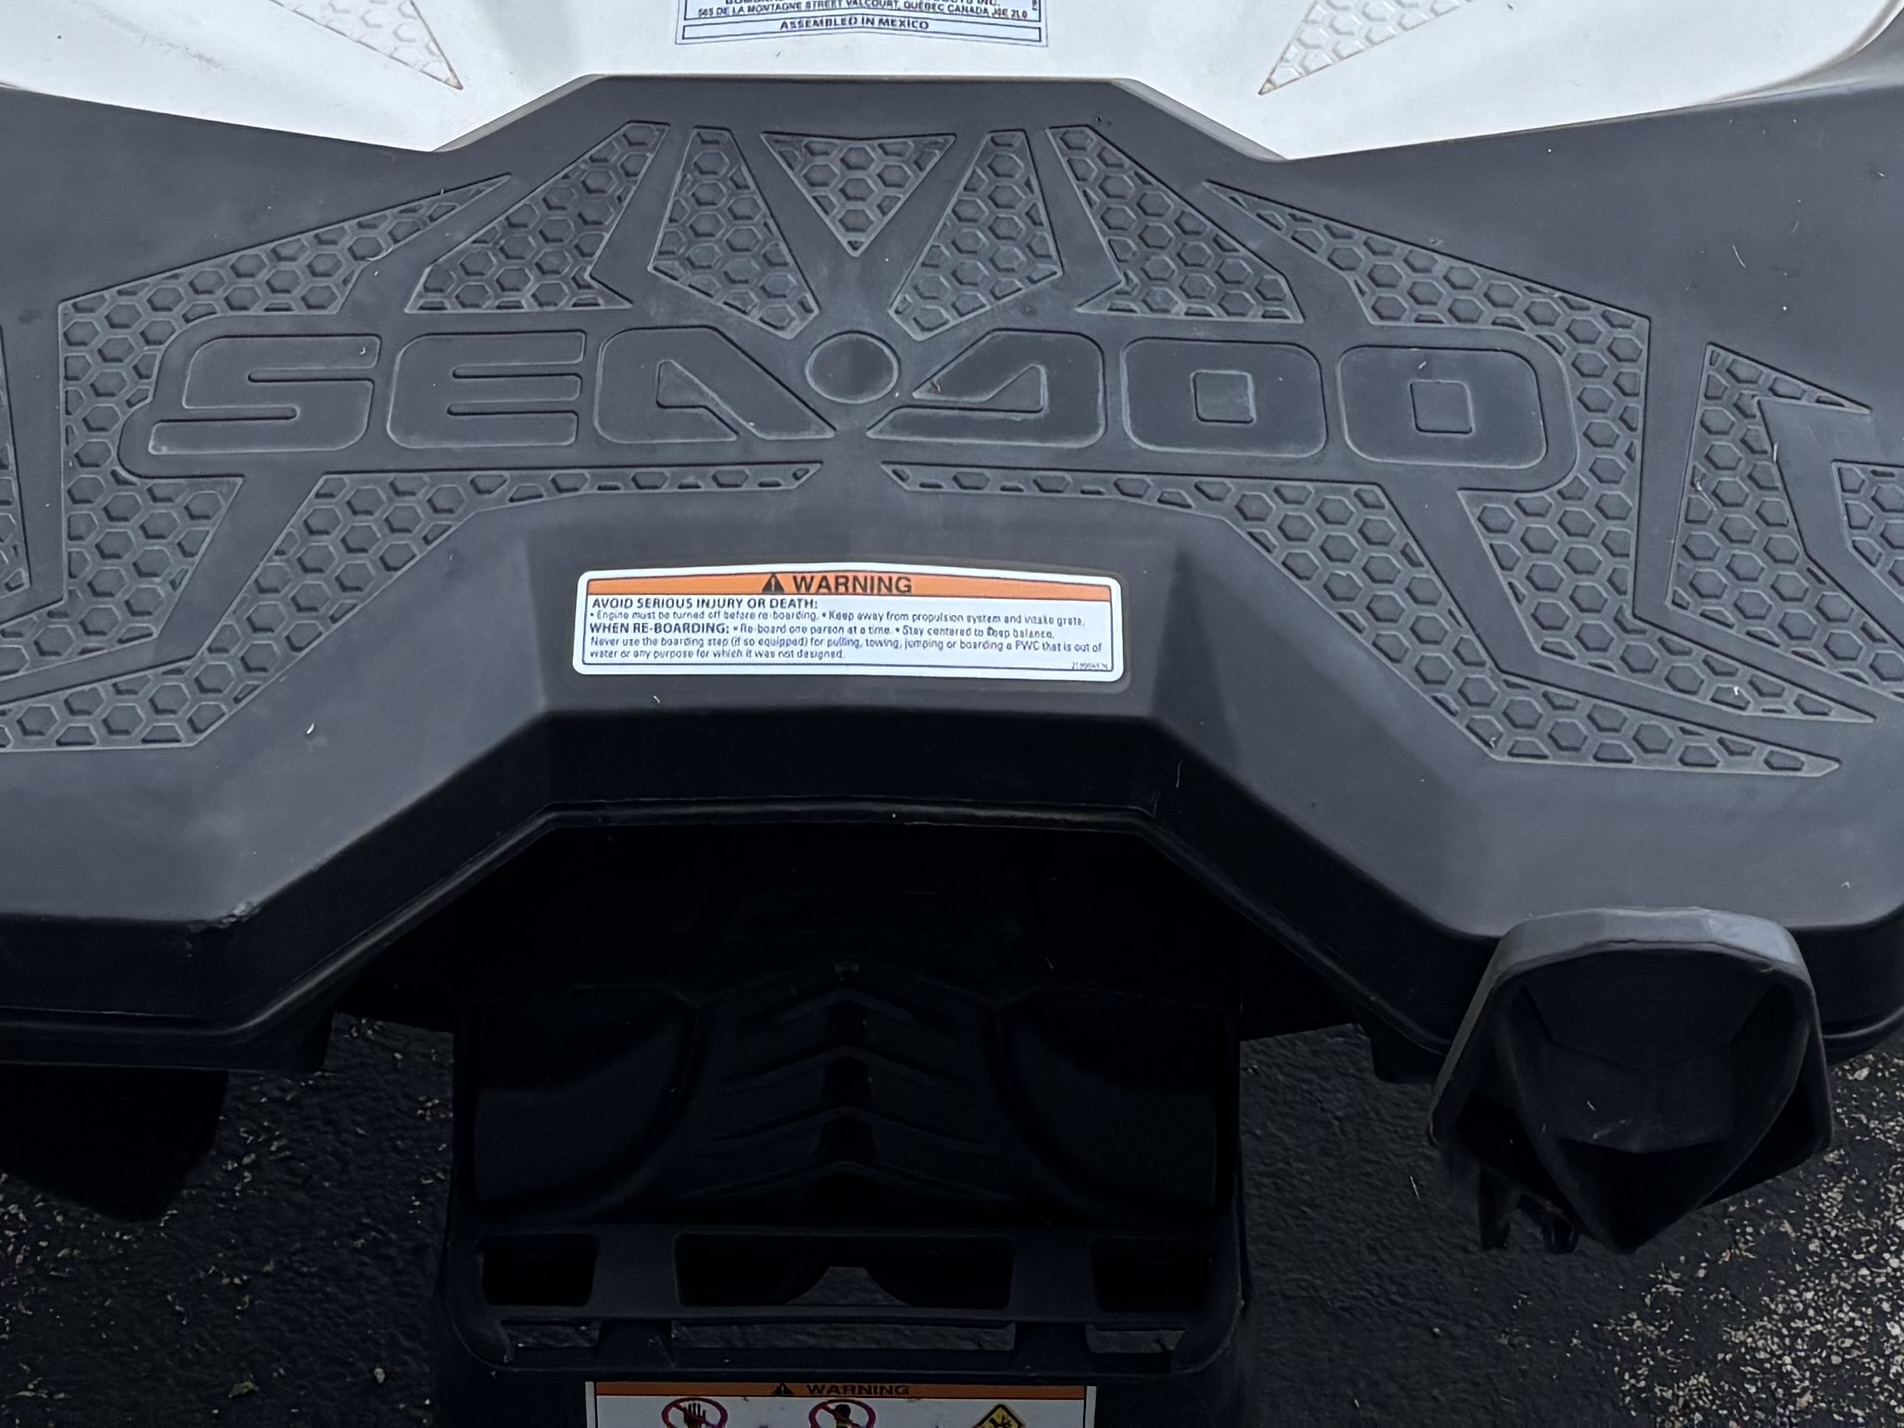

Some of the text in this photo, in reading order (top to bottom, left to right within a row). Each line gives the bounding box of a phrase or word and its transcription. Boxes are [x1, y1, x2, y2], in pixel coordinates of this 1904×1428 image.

[792, 575, 913, 595] WARNING
[592, 598, 818, 609] AVOID SERIOUS INJURY OR DEATH:
[596, 610, 629, 621] Engine
[632, 610, 656, 620] must
[673, 610, 704, 620] turned
[708, 610, 721, 619] off
[829, 610, 854, 622] Keep
[856, 613, 883, 623] away
[885, 611, 909, 621] from
[912, 613, 963, 624] propulsion
[1004, 614, 1022, 624] and
[590, 623, 628, 633] WHEN
[633, 623, 729, 634] RE-BOARDING:
[902, 626, 924, 637] Stay
[590, 637, 619, 646] Never
[643, 637, 658, 646] the
[660, 637, 704, 648] boarding
[744, 638, 755, 646] so
[810, 637, 825, 646] for
[946, 640, 957, 649] or
[1015, 640, 1039, 651] PWC
[1063, 641, 1071, 652] is
[1092, 642, 1102, 652] of
[620, 649, 630, 658] or
[713, 648, 743, 658] which
[755, 650, 775, 658] was
[778, 649, 794, 658] not
[805, 1383, 910, 1398] WARNING
